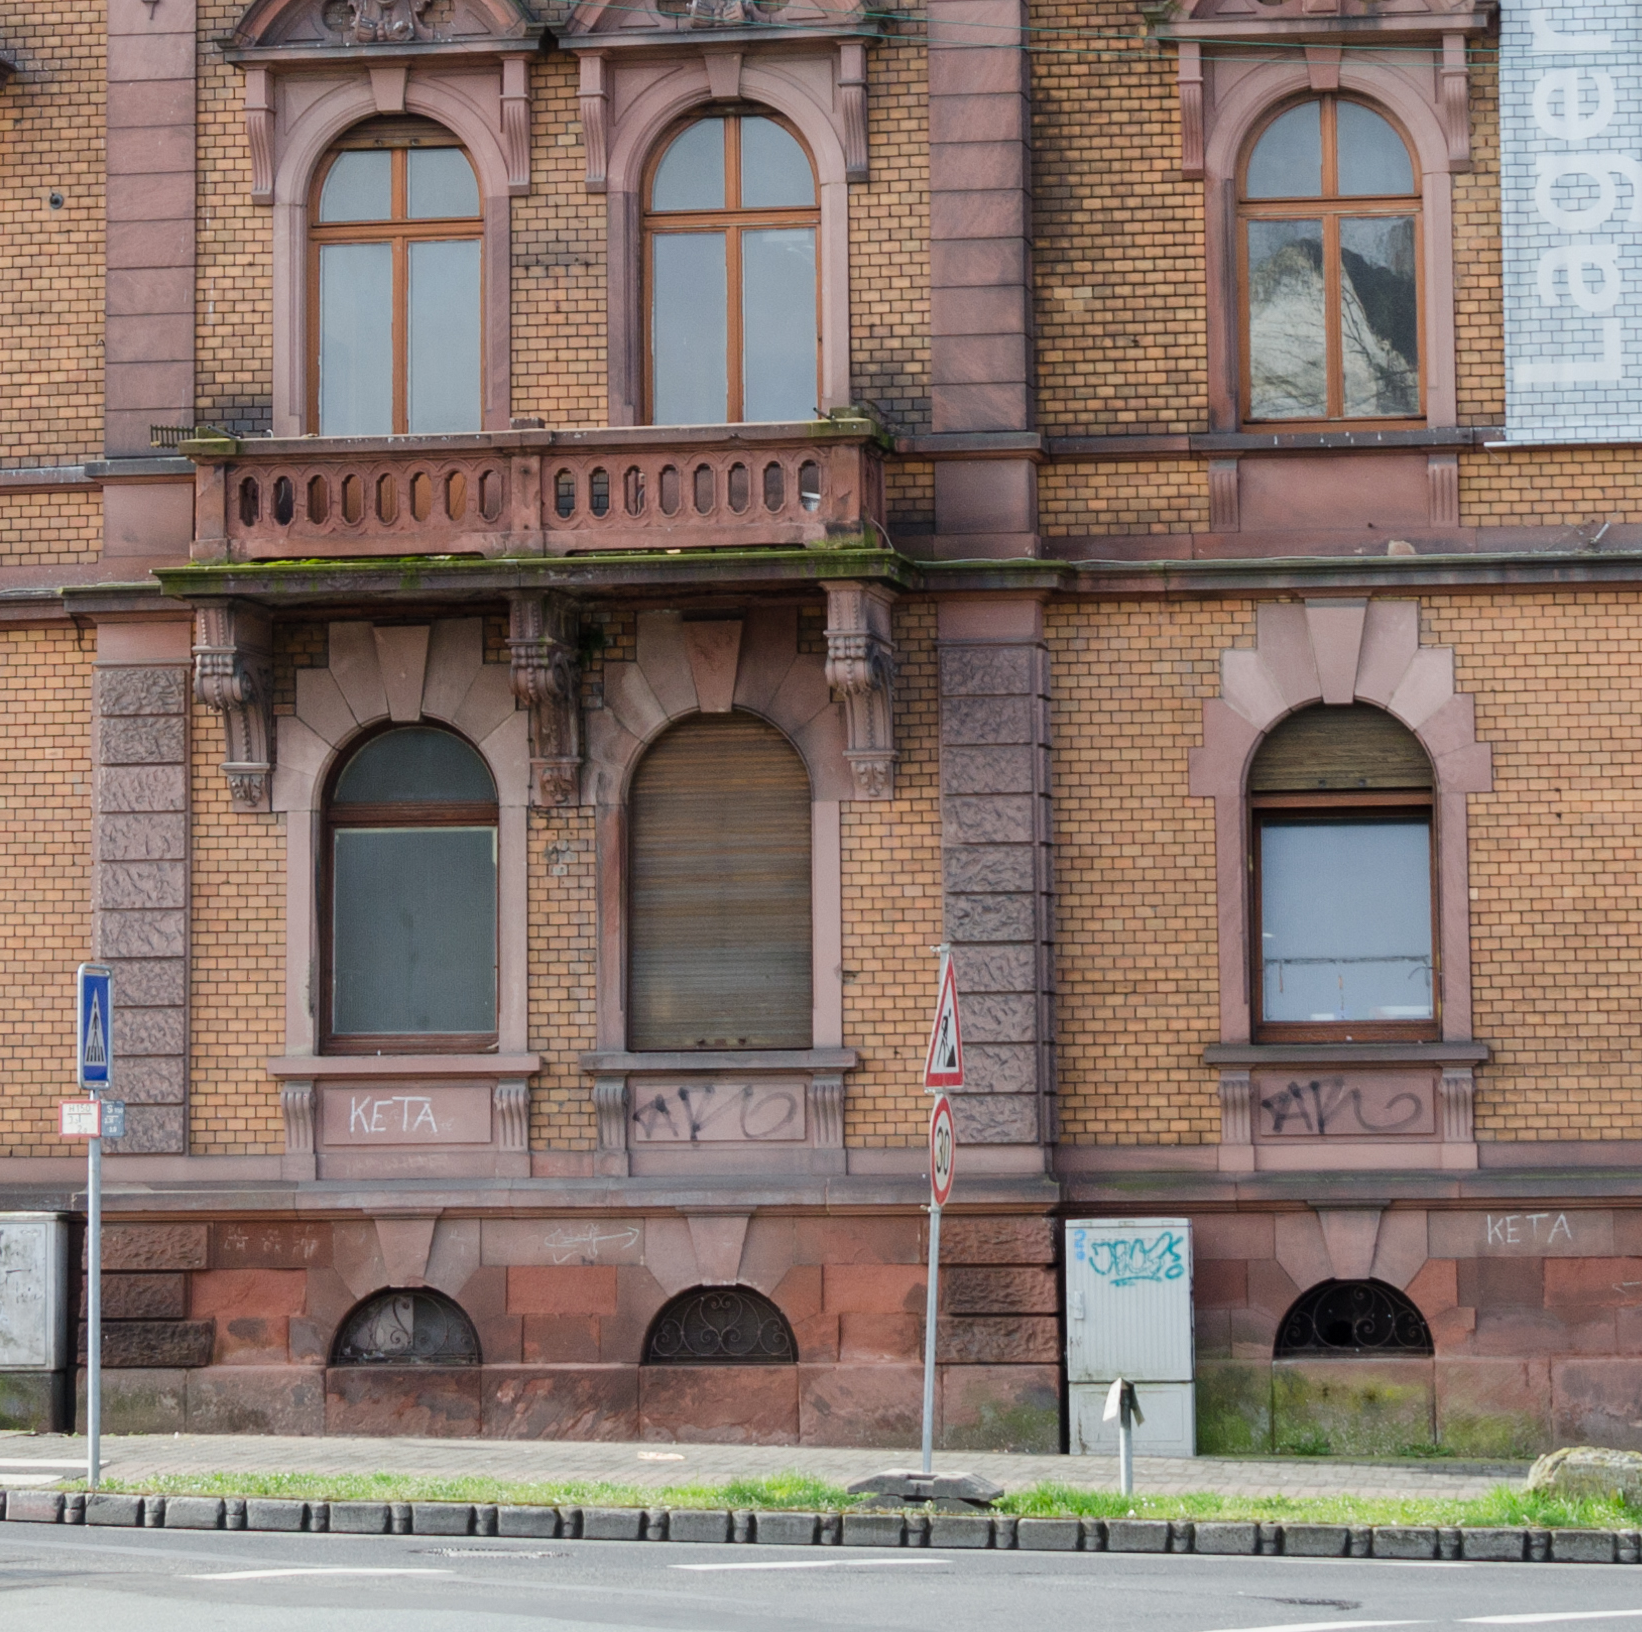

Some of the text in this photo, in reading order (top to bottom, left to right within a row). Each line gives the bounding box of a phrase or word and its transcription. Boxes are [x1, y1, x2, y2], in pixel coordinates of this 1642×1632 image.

[350, 1096, 438, 1133] KETA
[936, 1126, 950, 1176] 30
[1487, 1213, 1573, 1245] KETA
